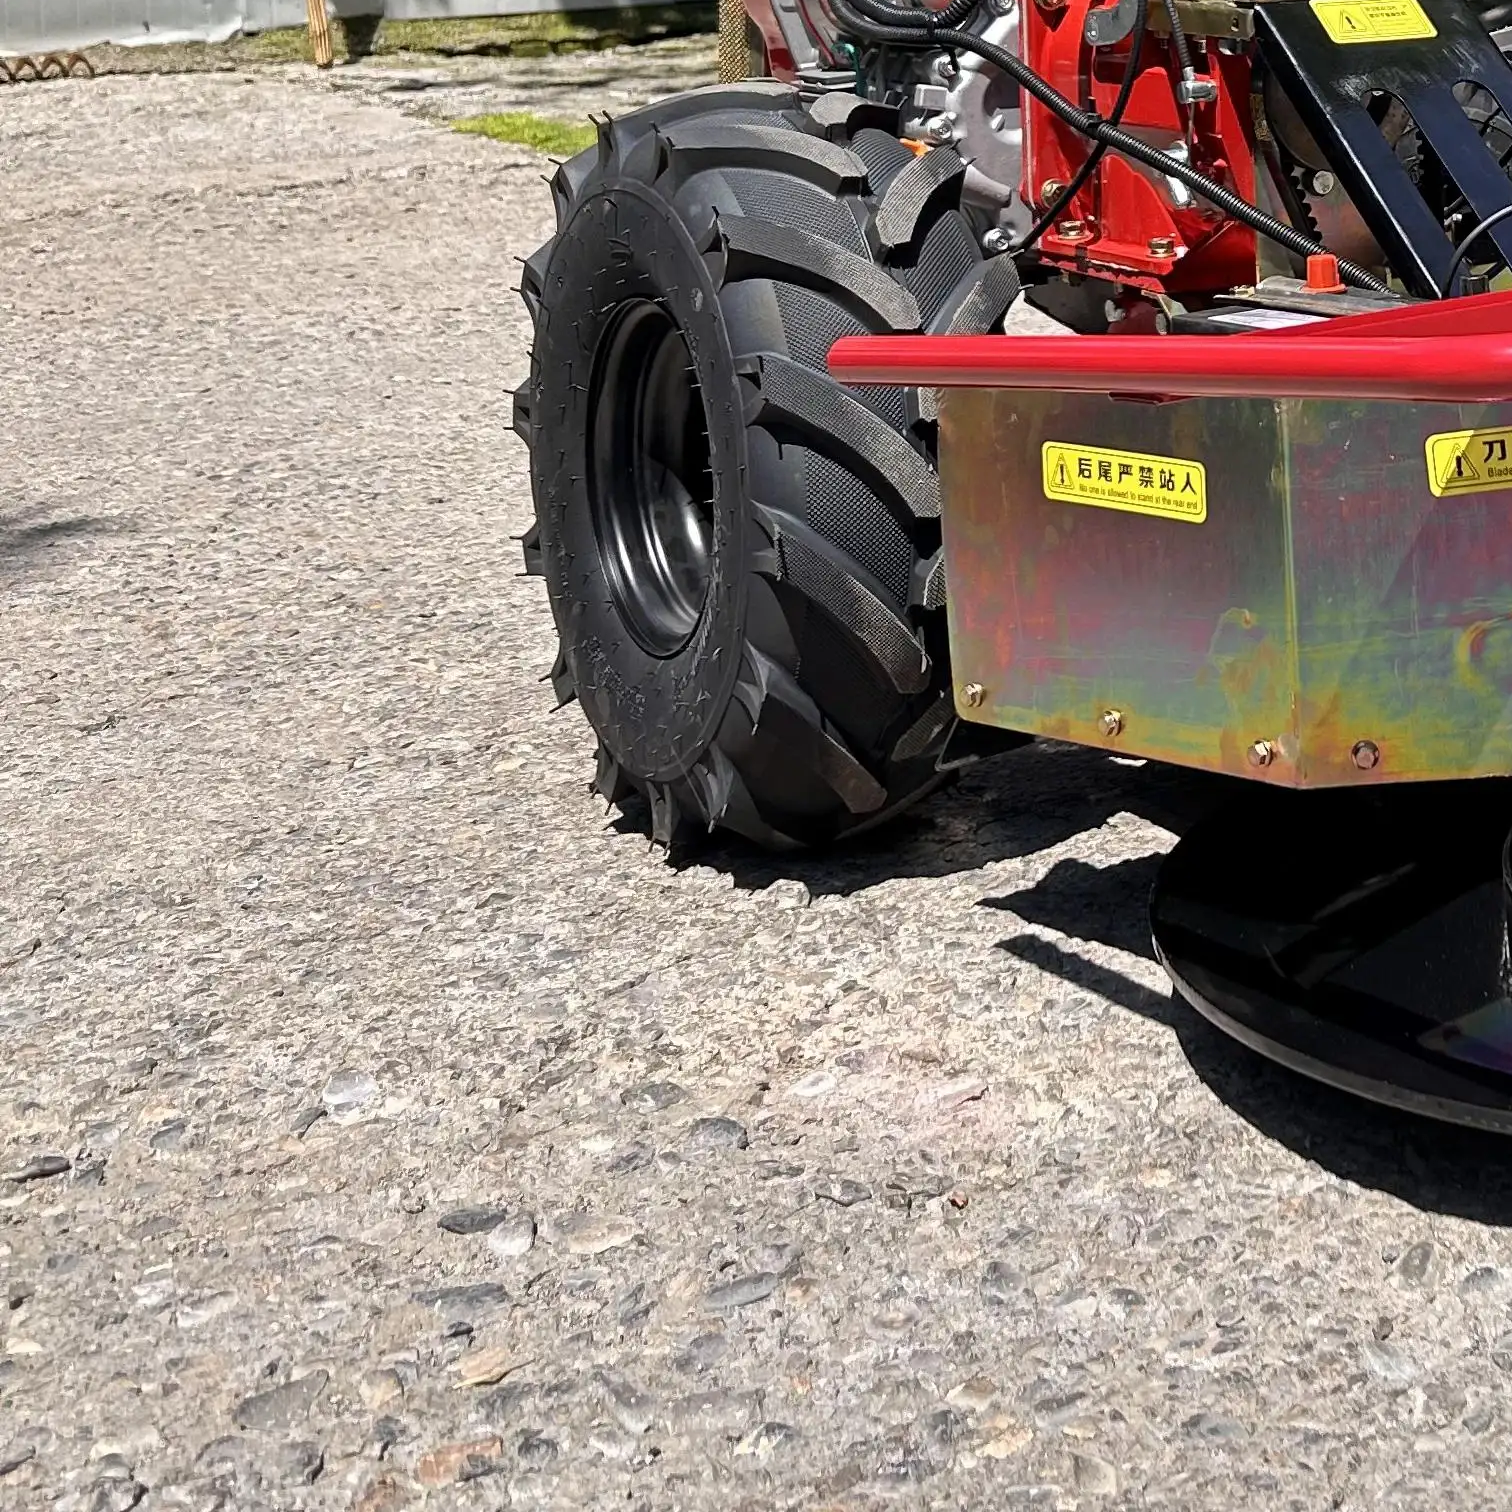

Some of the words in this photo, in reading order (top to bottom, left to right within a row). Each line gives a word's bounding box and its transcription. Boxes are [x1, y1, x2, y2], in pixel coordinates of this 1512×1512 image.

[1077, 457, 1198, 496] 后尾严禁站人
